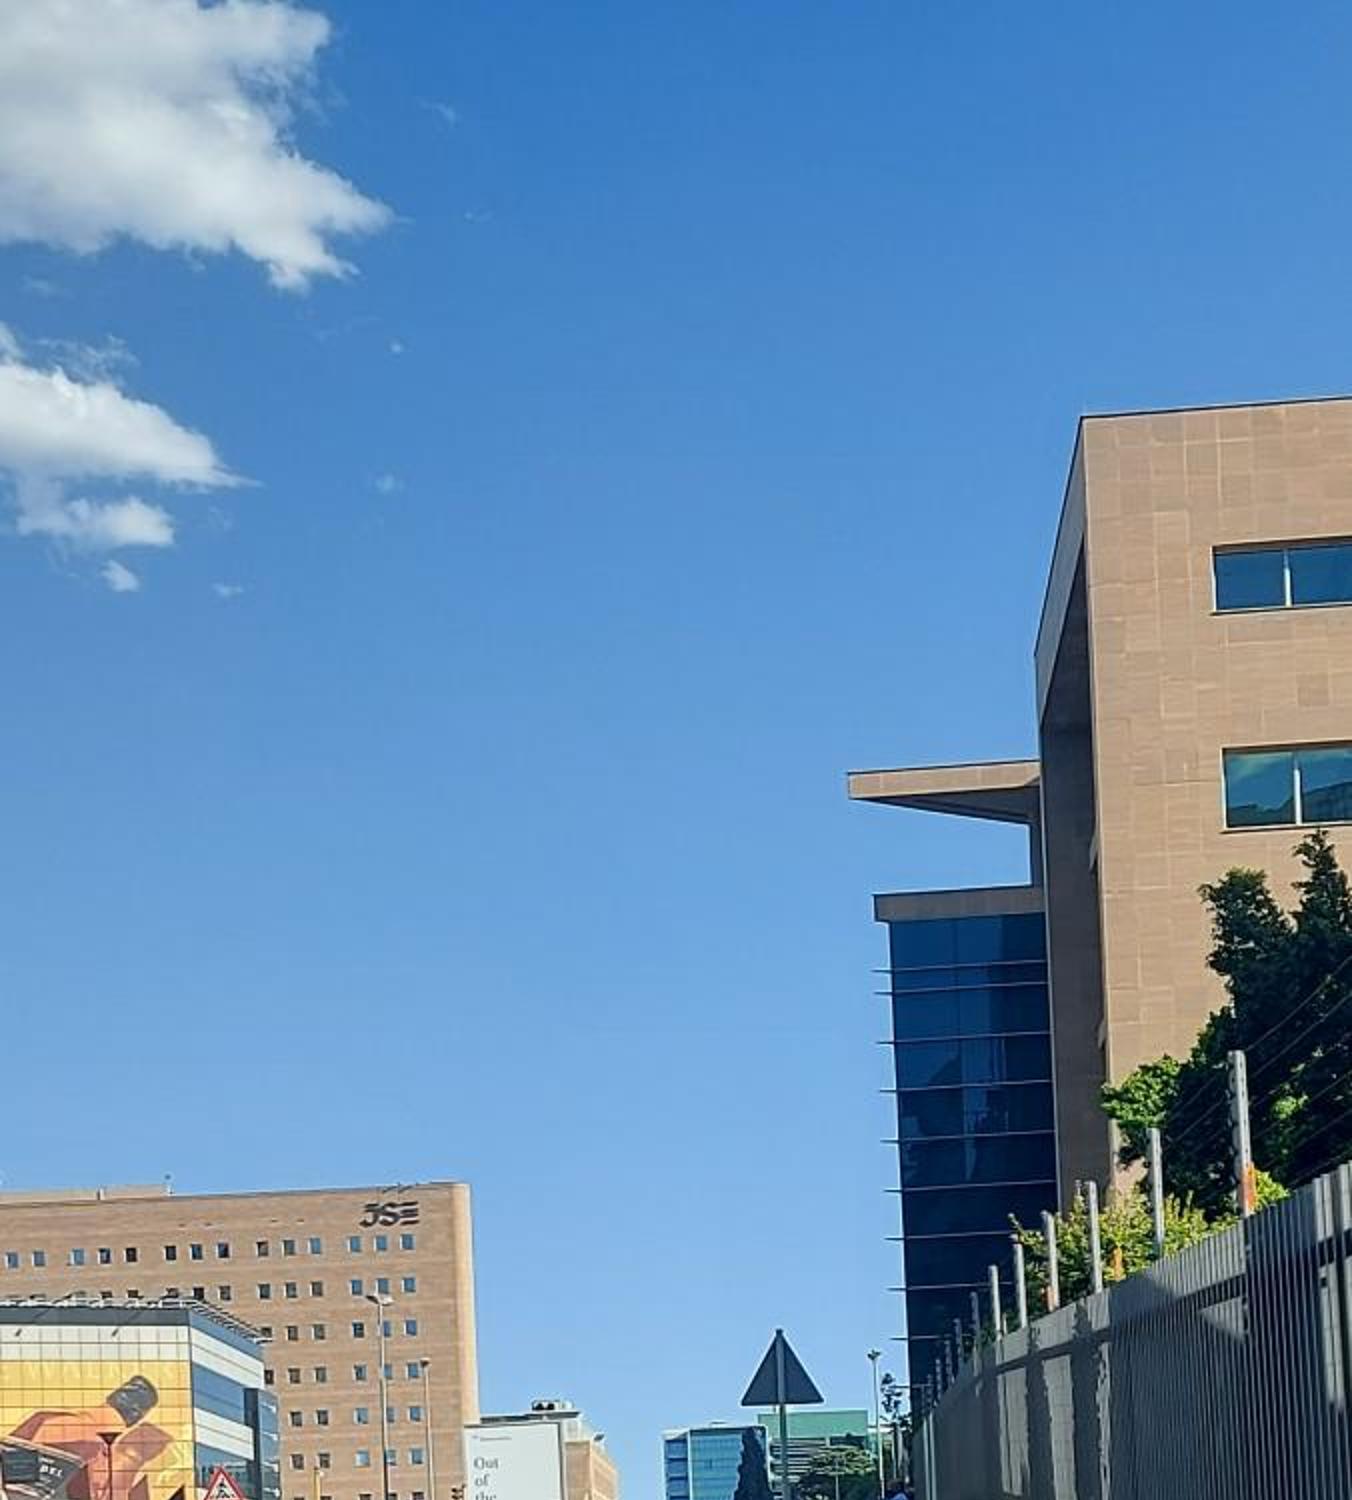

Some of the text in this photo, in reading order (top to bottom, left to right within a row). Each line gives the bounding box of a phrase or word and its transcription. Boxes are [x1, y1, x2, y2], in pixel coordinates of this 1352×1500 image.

[359, 1201, 420, 1227] JSE
[473, 1457, 499, 1470] Out
[474, 1474, 490, 1487] of
